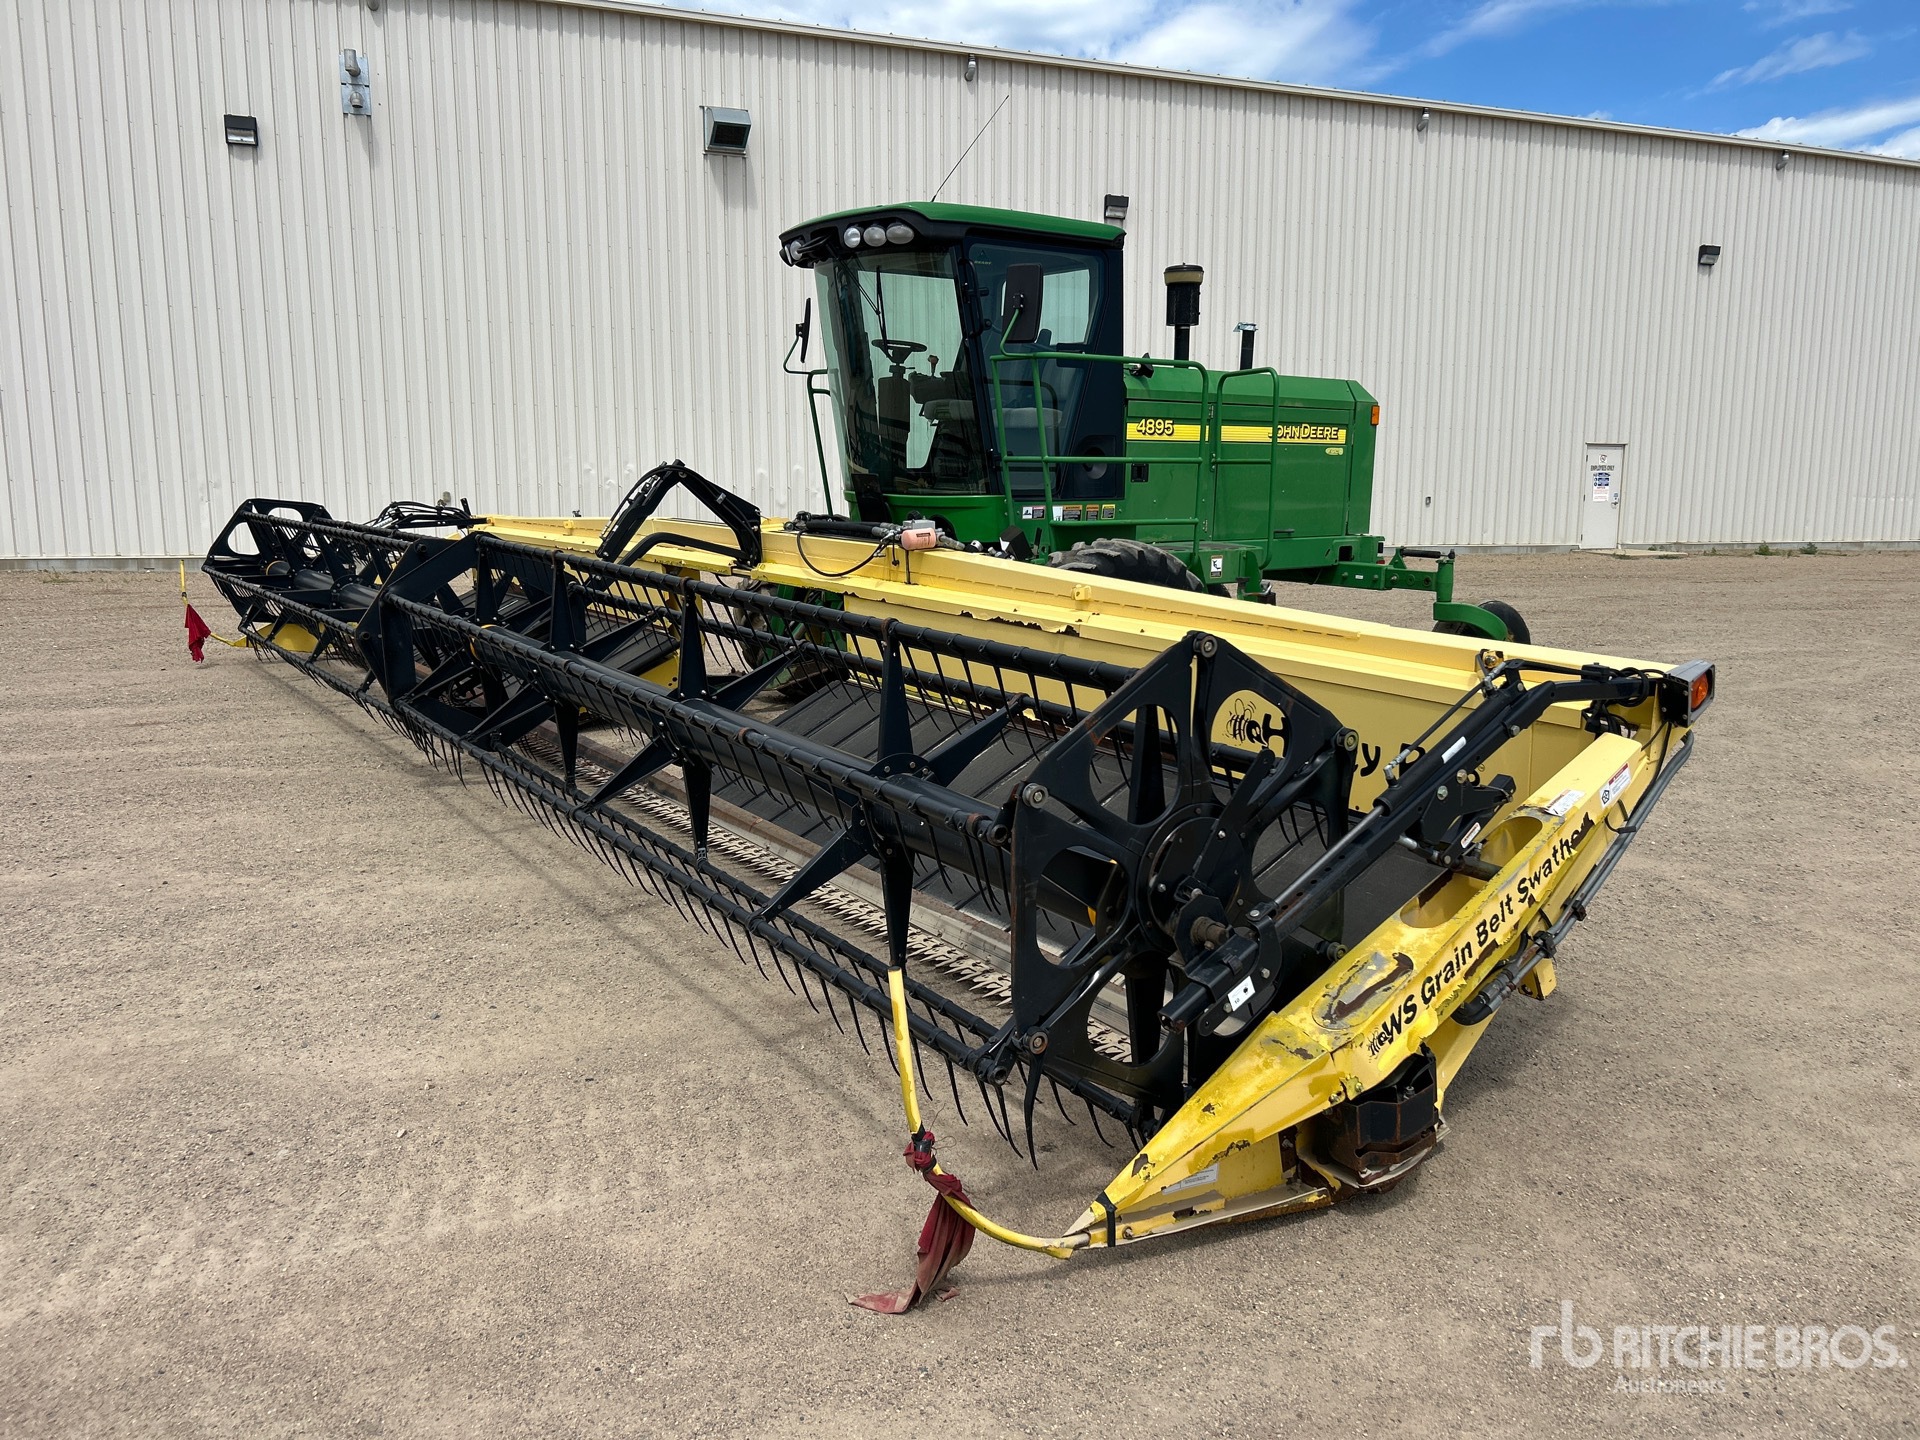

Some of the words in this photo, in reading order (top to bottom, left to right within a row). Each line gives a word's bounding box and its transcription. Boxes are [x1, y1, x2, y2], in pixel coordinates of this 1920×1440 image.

[1136, 418, 1175, 436] 4895
[1301, 422, 1340, 441] DEERE
[1421, 940, 1474, 1006] Grain
[1475, 893, 1514, 948] Belt
